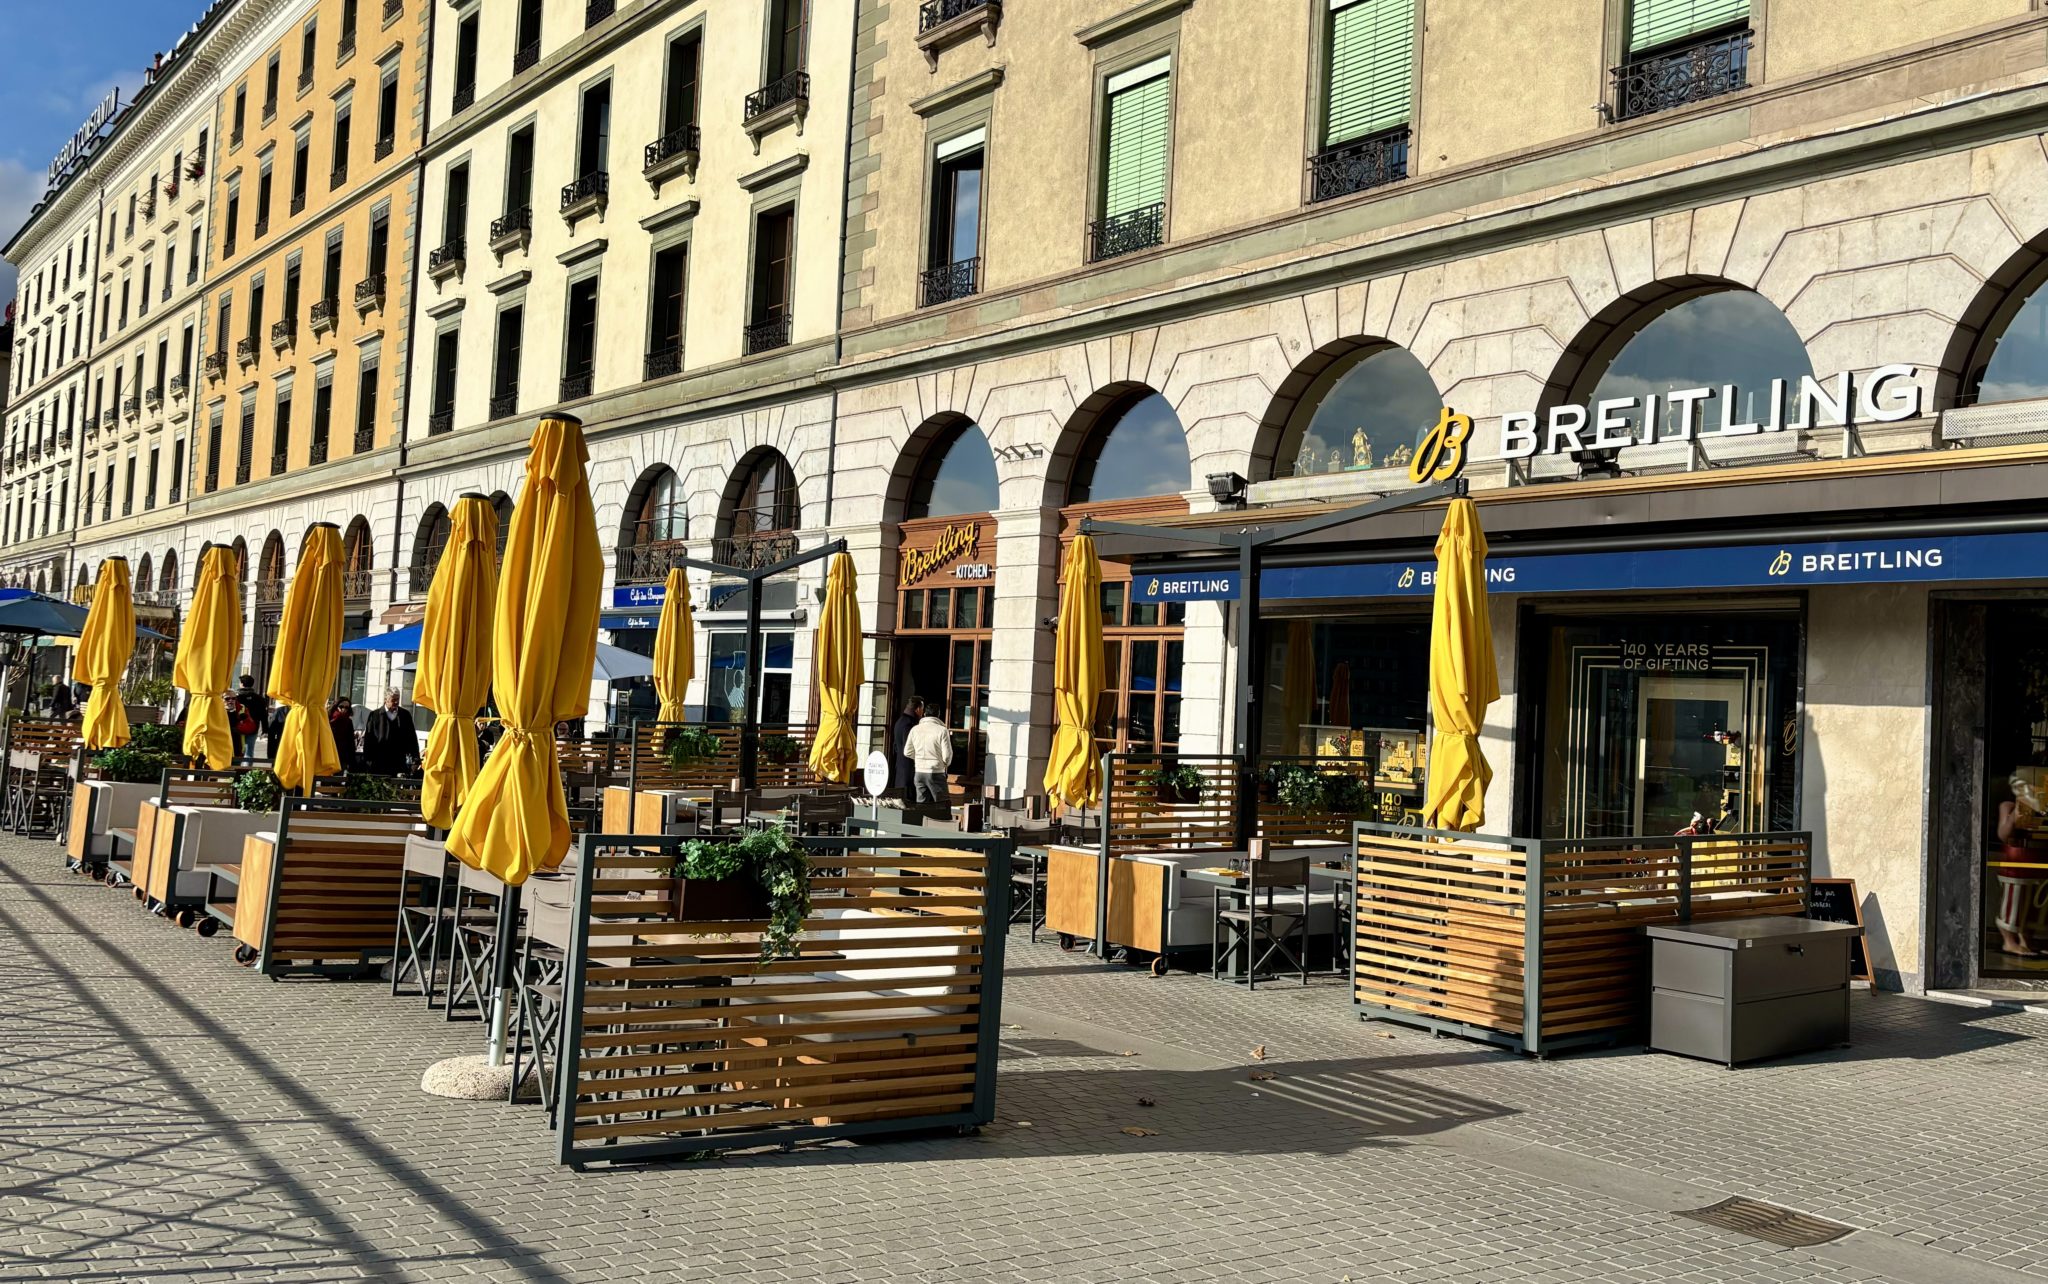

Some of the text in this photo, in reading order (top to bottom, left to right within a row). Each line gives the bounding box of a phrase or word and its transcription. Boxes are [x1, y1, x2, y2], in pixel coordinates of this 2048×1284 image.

[1500, 363, 1919, 459] BREITLING
[902, 522, 975, 585] Breitling
[1802, 549, 1943, 572] BREITLING
[956, 563, 988, 579] KITCHEN
[1163, 579, 1229, 594] BREITLING
[1623, 643, 1709, 656] 140 YEARS
[1623, 659, 1709, 671] OF GIFTING
[1381, 792, 1402, 806] 140
